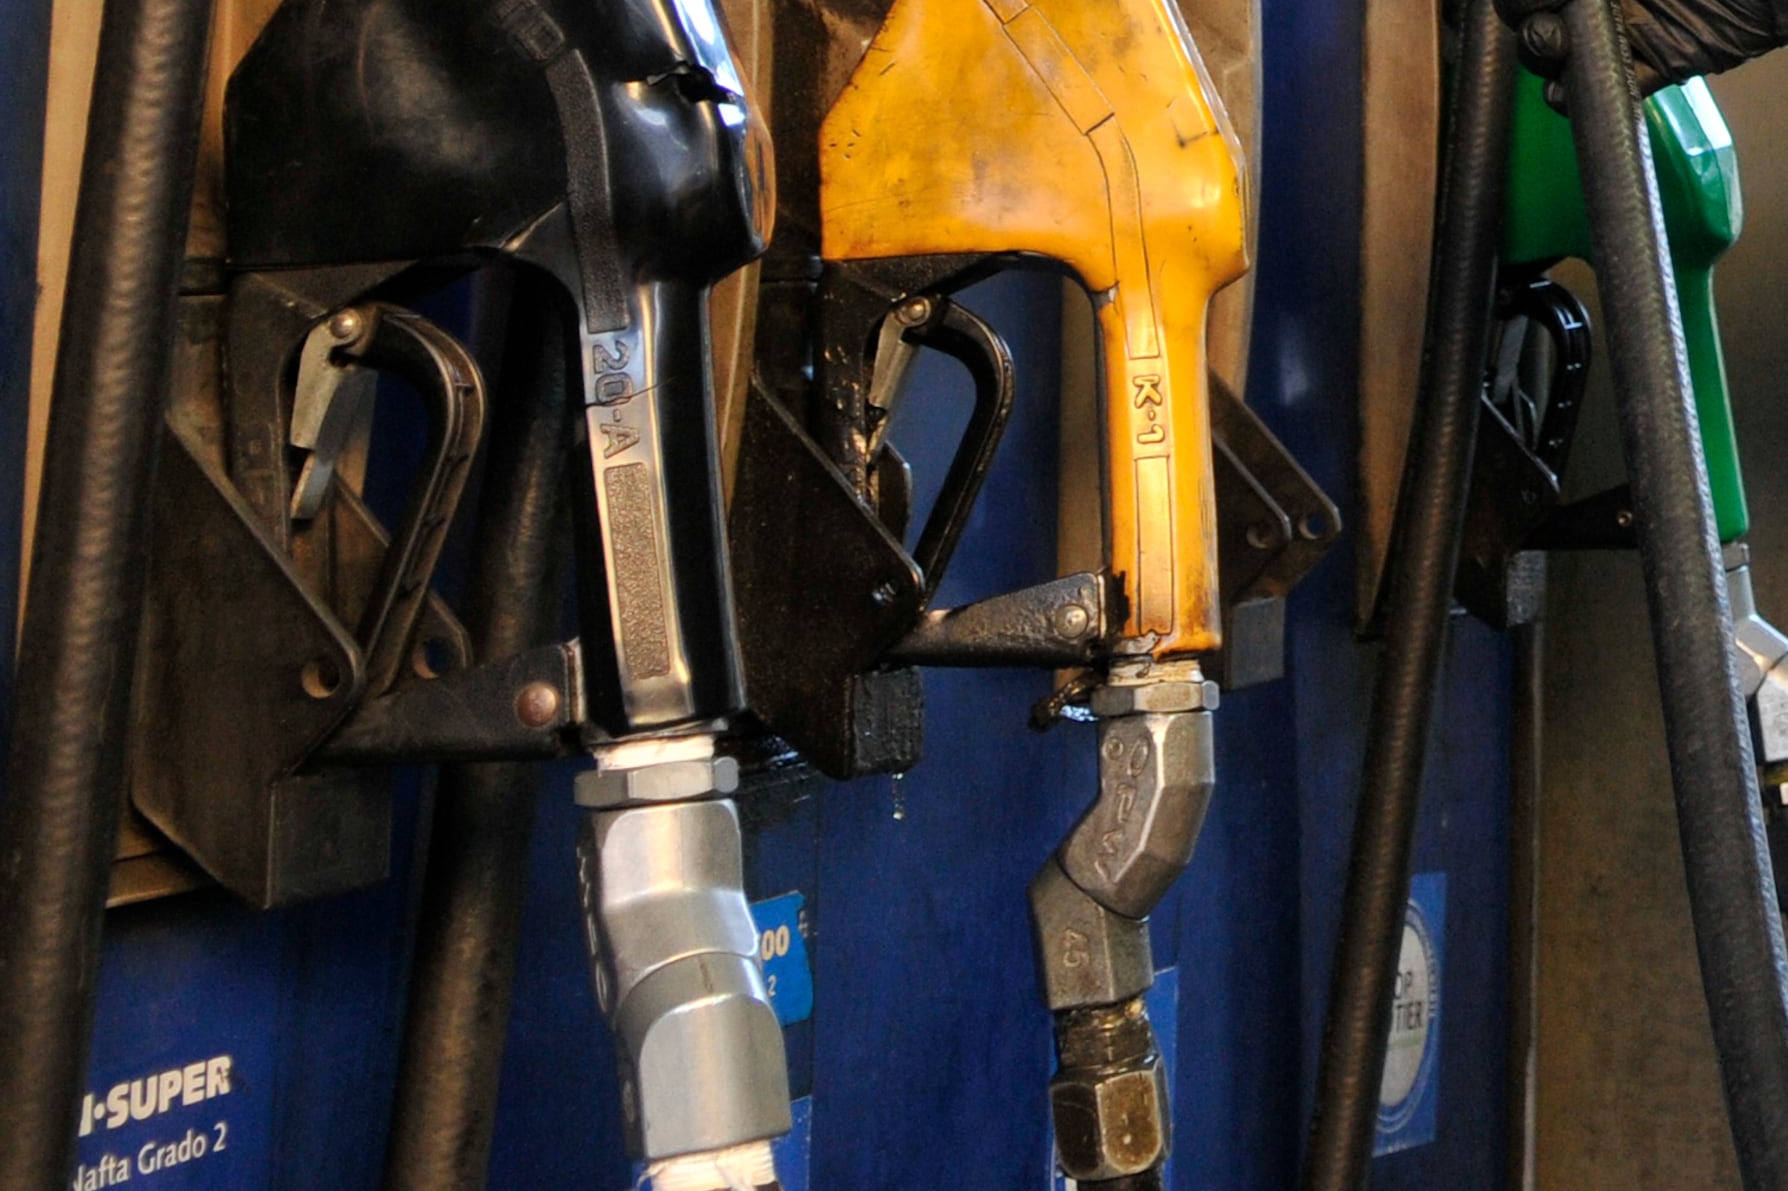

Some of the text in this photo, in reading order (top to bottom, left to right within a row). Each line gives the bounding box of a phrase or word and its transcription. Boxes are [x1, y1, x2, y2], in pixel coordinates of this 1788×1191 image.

[768, 974, 778, 997] 2
[137, 1128, 207, 1175] Grado
[212, 1122, 228, 1152] 2
